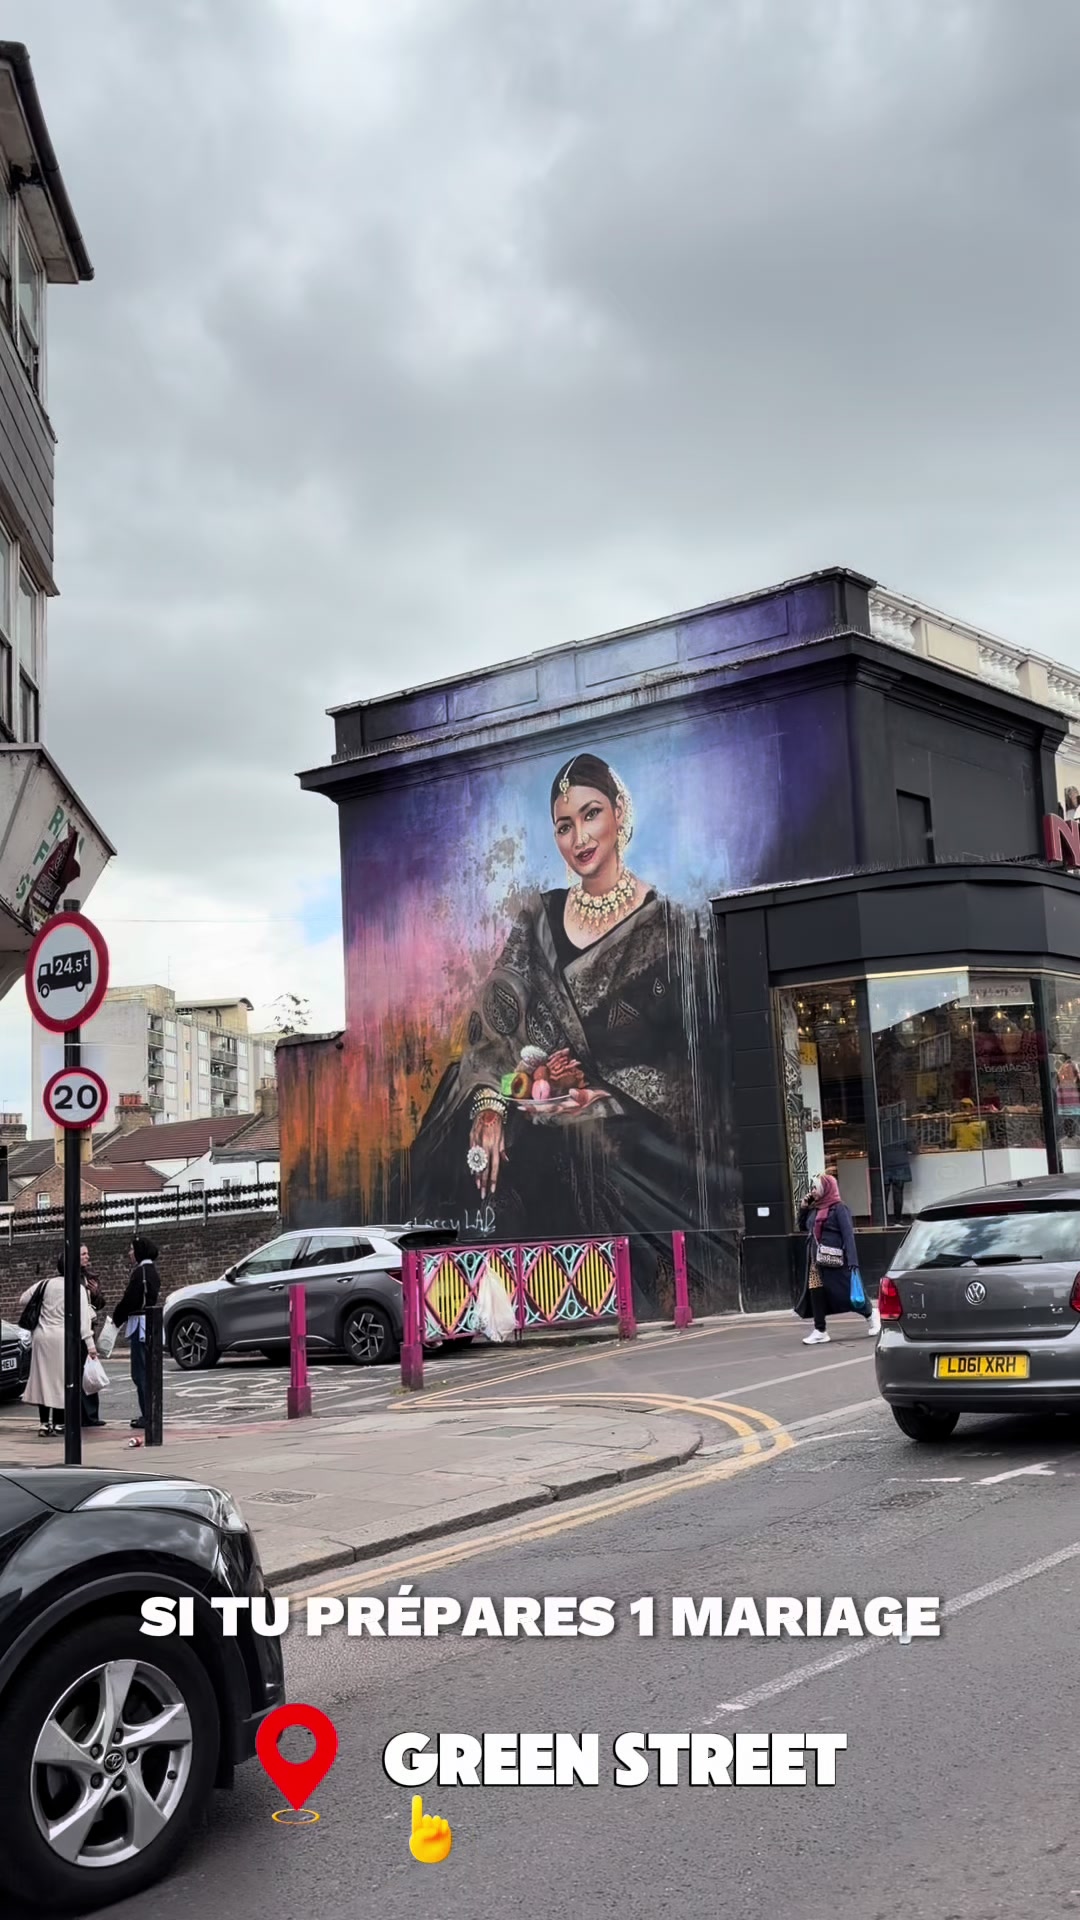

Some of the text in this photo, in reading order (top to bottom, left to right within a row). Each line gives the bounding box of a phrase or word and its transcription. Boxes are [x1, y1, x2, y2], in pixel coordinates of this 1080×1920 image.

[55, 954, 88, 976] 24.5t
[54, 1084, 98, 1110] 20
[947, 1357, 1016, 1373] LD61 XRH
